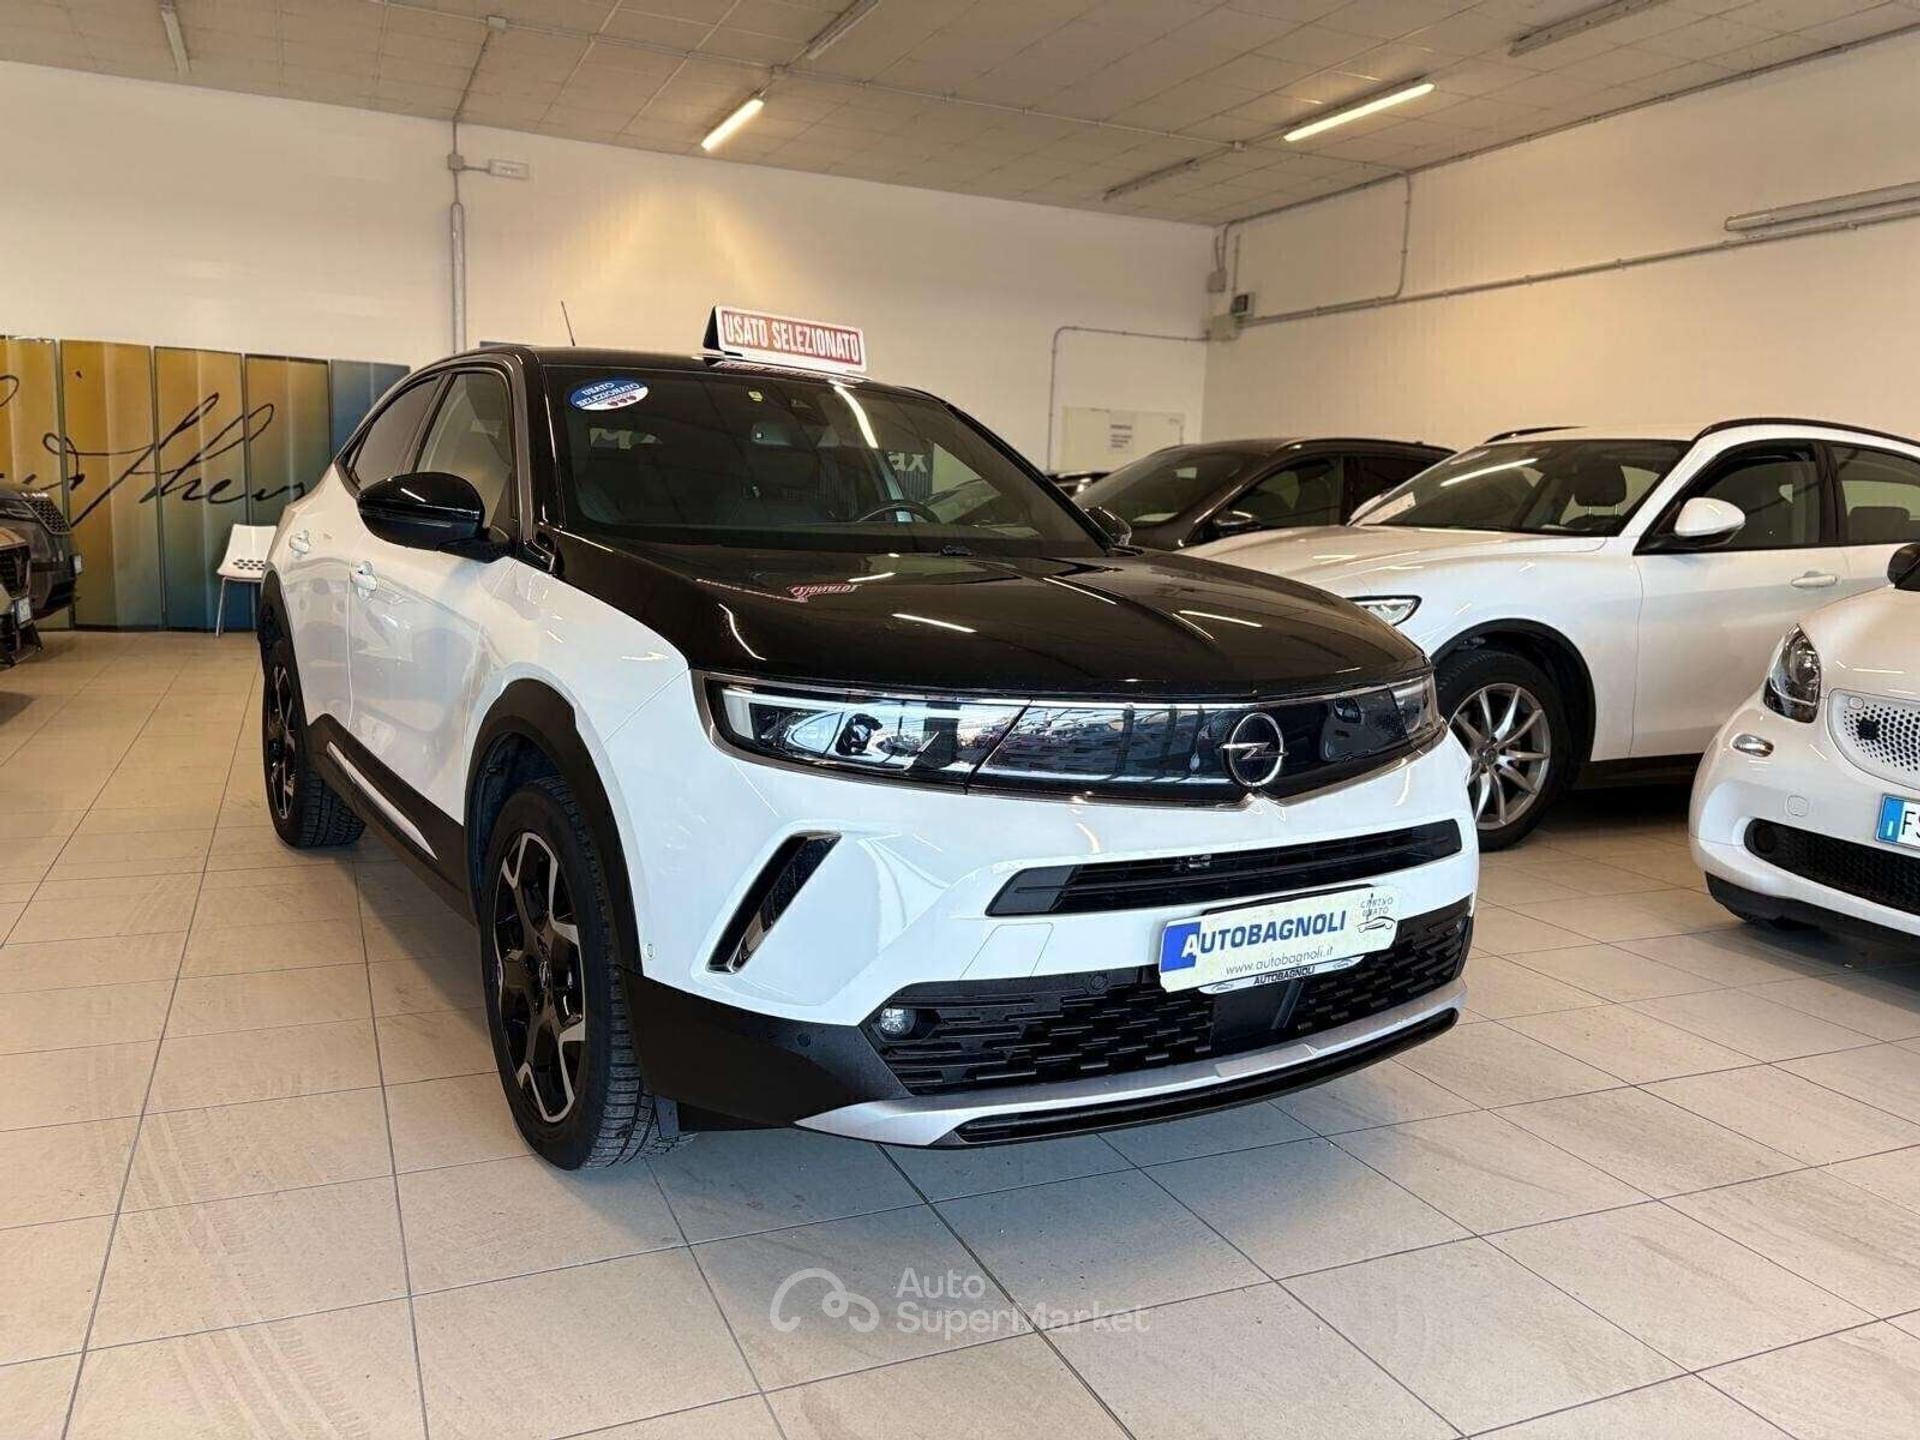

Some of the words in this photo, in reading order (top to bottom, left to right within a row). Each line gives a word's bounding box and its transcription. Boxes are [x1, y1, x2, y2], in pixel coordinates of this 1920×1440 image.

[723, 313, 769, 348] USATO
[771, 321, 860, 363] SELEZIONATO
[576, 382, 641, 407] SELEZIONATO
[581, 382, 615, 396] USATO
[1901, 810, 1920, 839] F
[1181, 910, 1347, 959] AUTOBAGNOLI
[1225, 945, 1334, 976] www.autobagnoli.it
[1253, 966, 1316, 985] AUTOBAGNOLI
